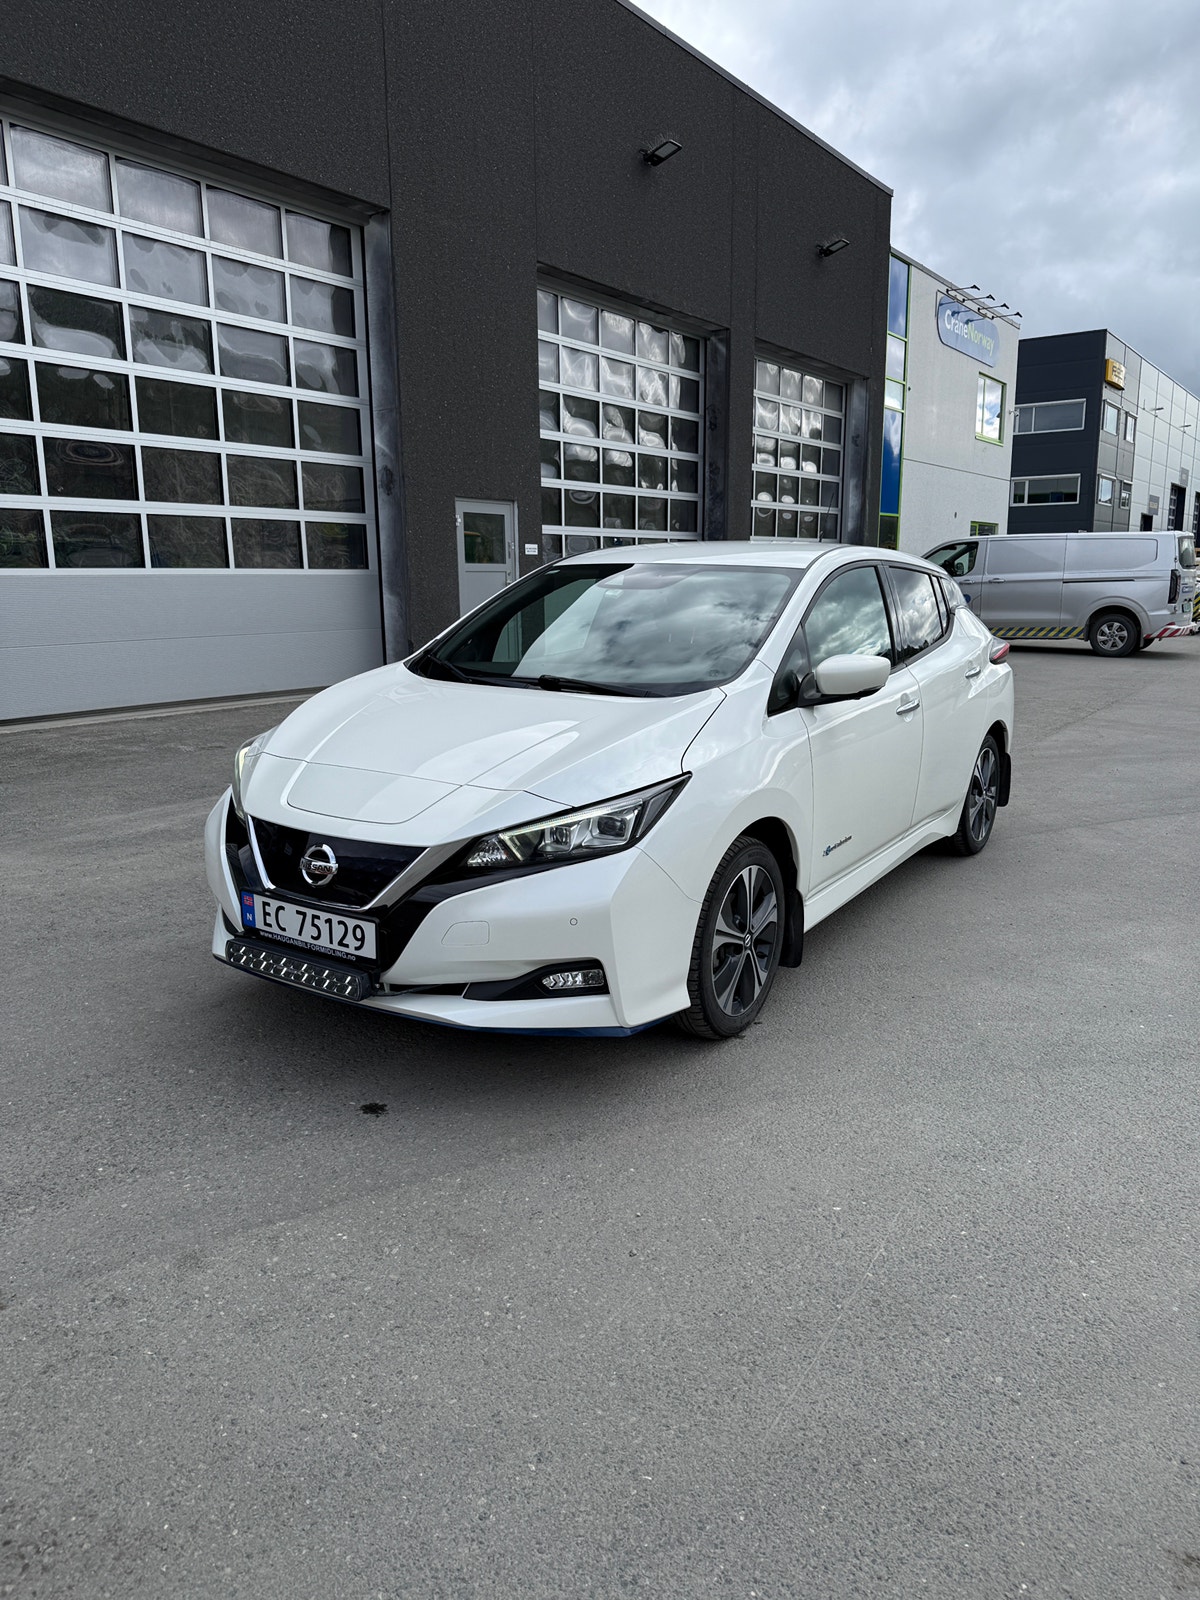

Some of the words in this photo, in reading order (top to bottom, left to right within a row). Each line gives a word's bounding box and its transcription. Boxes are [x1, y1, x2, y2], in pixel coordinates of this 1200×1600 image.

[944, 309, 995, 357] CraneNorway
[301, 859, 332, 872] NISSAN
[246, 913, 253, 921] N
[263, 901, 287, 931] EC
[295, 910, 366, 951] 75129
[260, 931, 356, 961] www.HAUGANBILFORMIDLING.no
